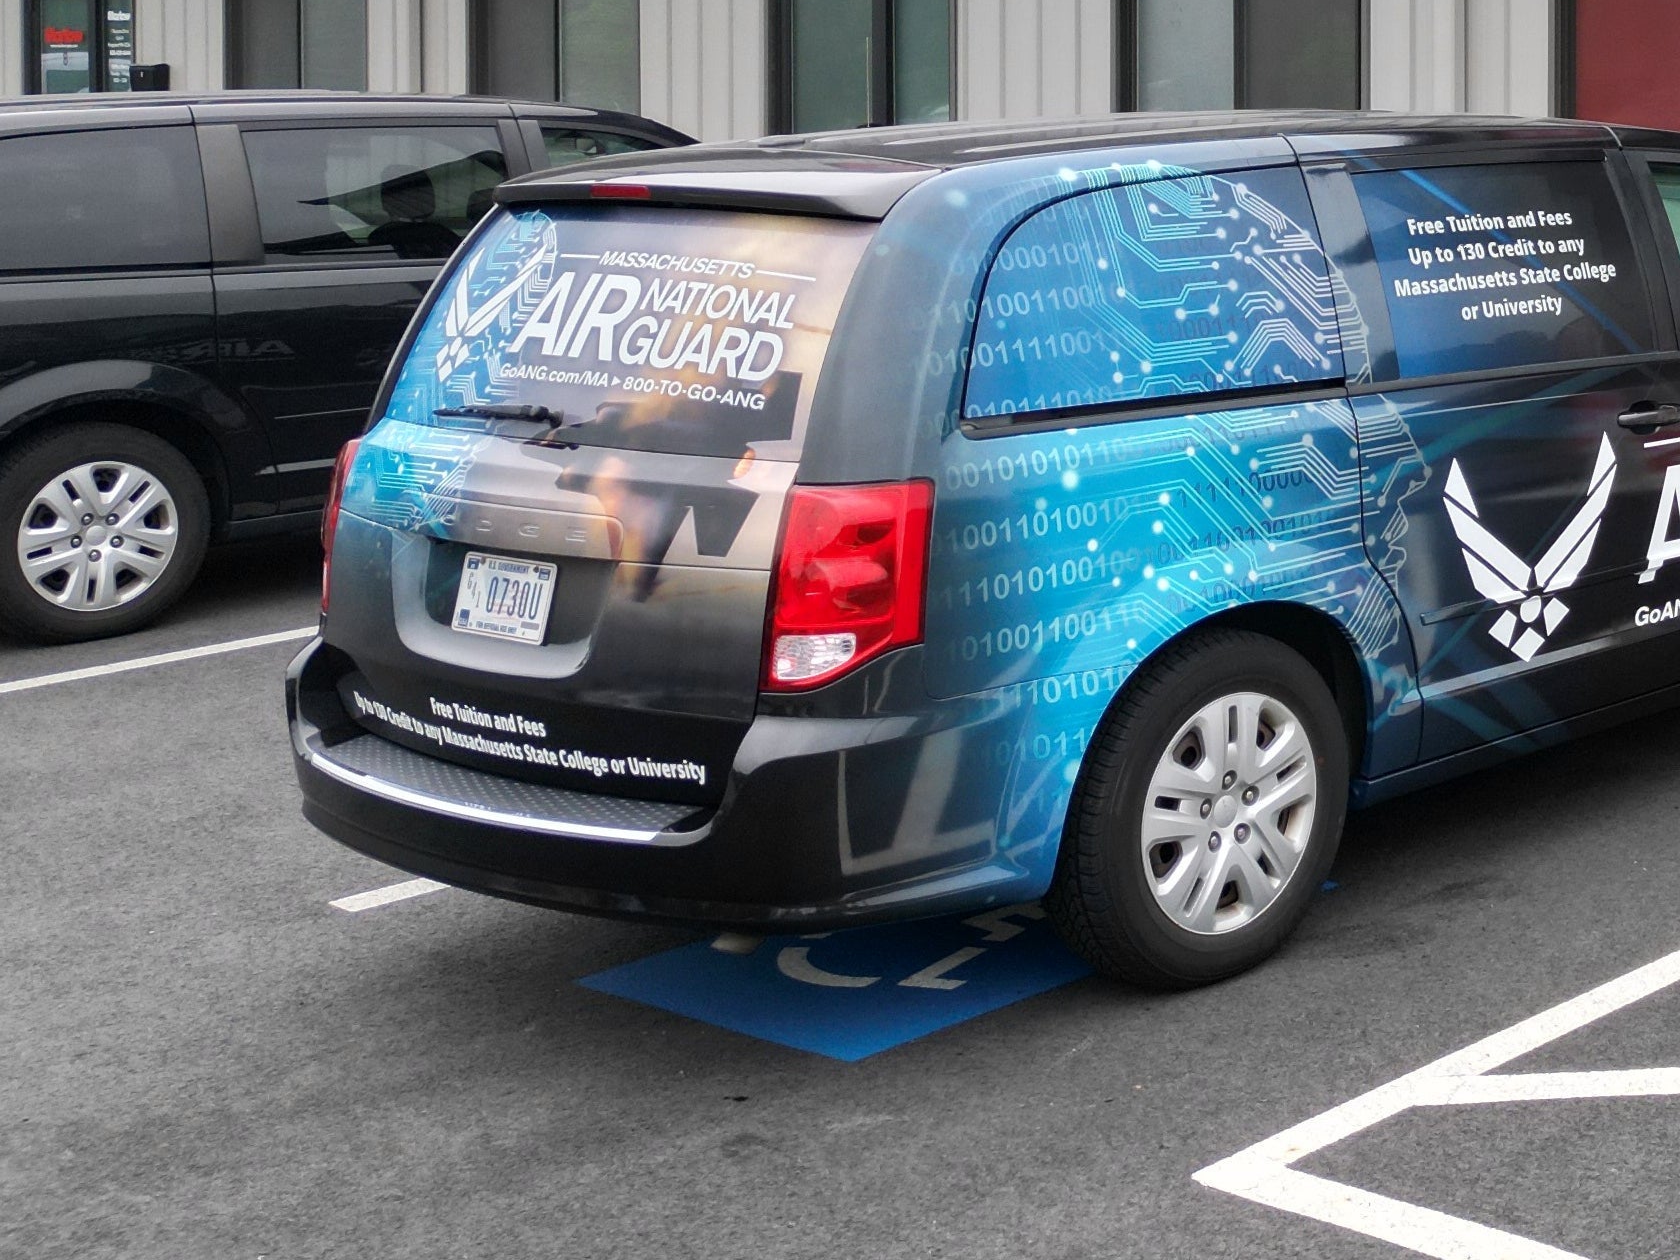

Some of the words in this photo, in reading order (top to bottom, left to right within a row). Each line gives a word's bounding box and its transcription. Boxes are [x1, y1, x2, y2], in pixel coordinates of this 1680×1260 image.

[1407, 218, 1445, 236] Free
[1445, 213, 1504, 234] Tuition
[1507, 210, 1536, 230] and
[1537, 210, 1573, 227] Fees
[598, 250, 756, 278] MASSACHUSETTS
[1407, 247, 1432, 269] Up
[1437, 246, 1454, 263] to
[1457, 243, 1485, 261] 130
[1488, 238, 1536, 259] Credit
[1539, 238, 1555, 254] to
[1558, 238, 1585, 256] any
[1394, 269, 1518, 297] Massachusetts
[1519, 266, 1561, 285] State
[1563, 261, 1616, 283] College
[505, 271, 642, 362] AIR
[640, 277, 797, 329] NATIONAL
[1461, 305, 1478, 321] or
[1482, 294, 1562, 319] University
[618, 315, 784, 382] GUARD
[499, 363, 609, 388] GoANG.com/MA
[622, 375, 766, 411] 800-TO-GO-ANG
[486, 576, 543, 620] 0730U
[430, 697, 454, 720] Free
[452, 702, 493, 729] Tuition
[494, 713, 517, 733] and
[516, 715, 547, 738] Fees
[412, 718, 425, 736] to
[424, 723, 443, 746] any
[441, 725, 524, 761] Massachusetts
[523, 744, 559, 766] State
[559, 749, 609, 777] College
[611, 758, 628, 774] or
[627, 756, 706, 785] University
